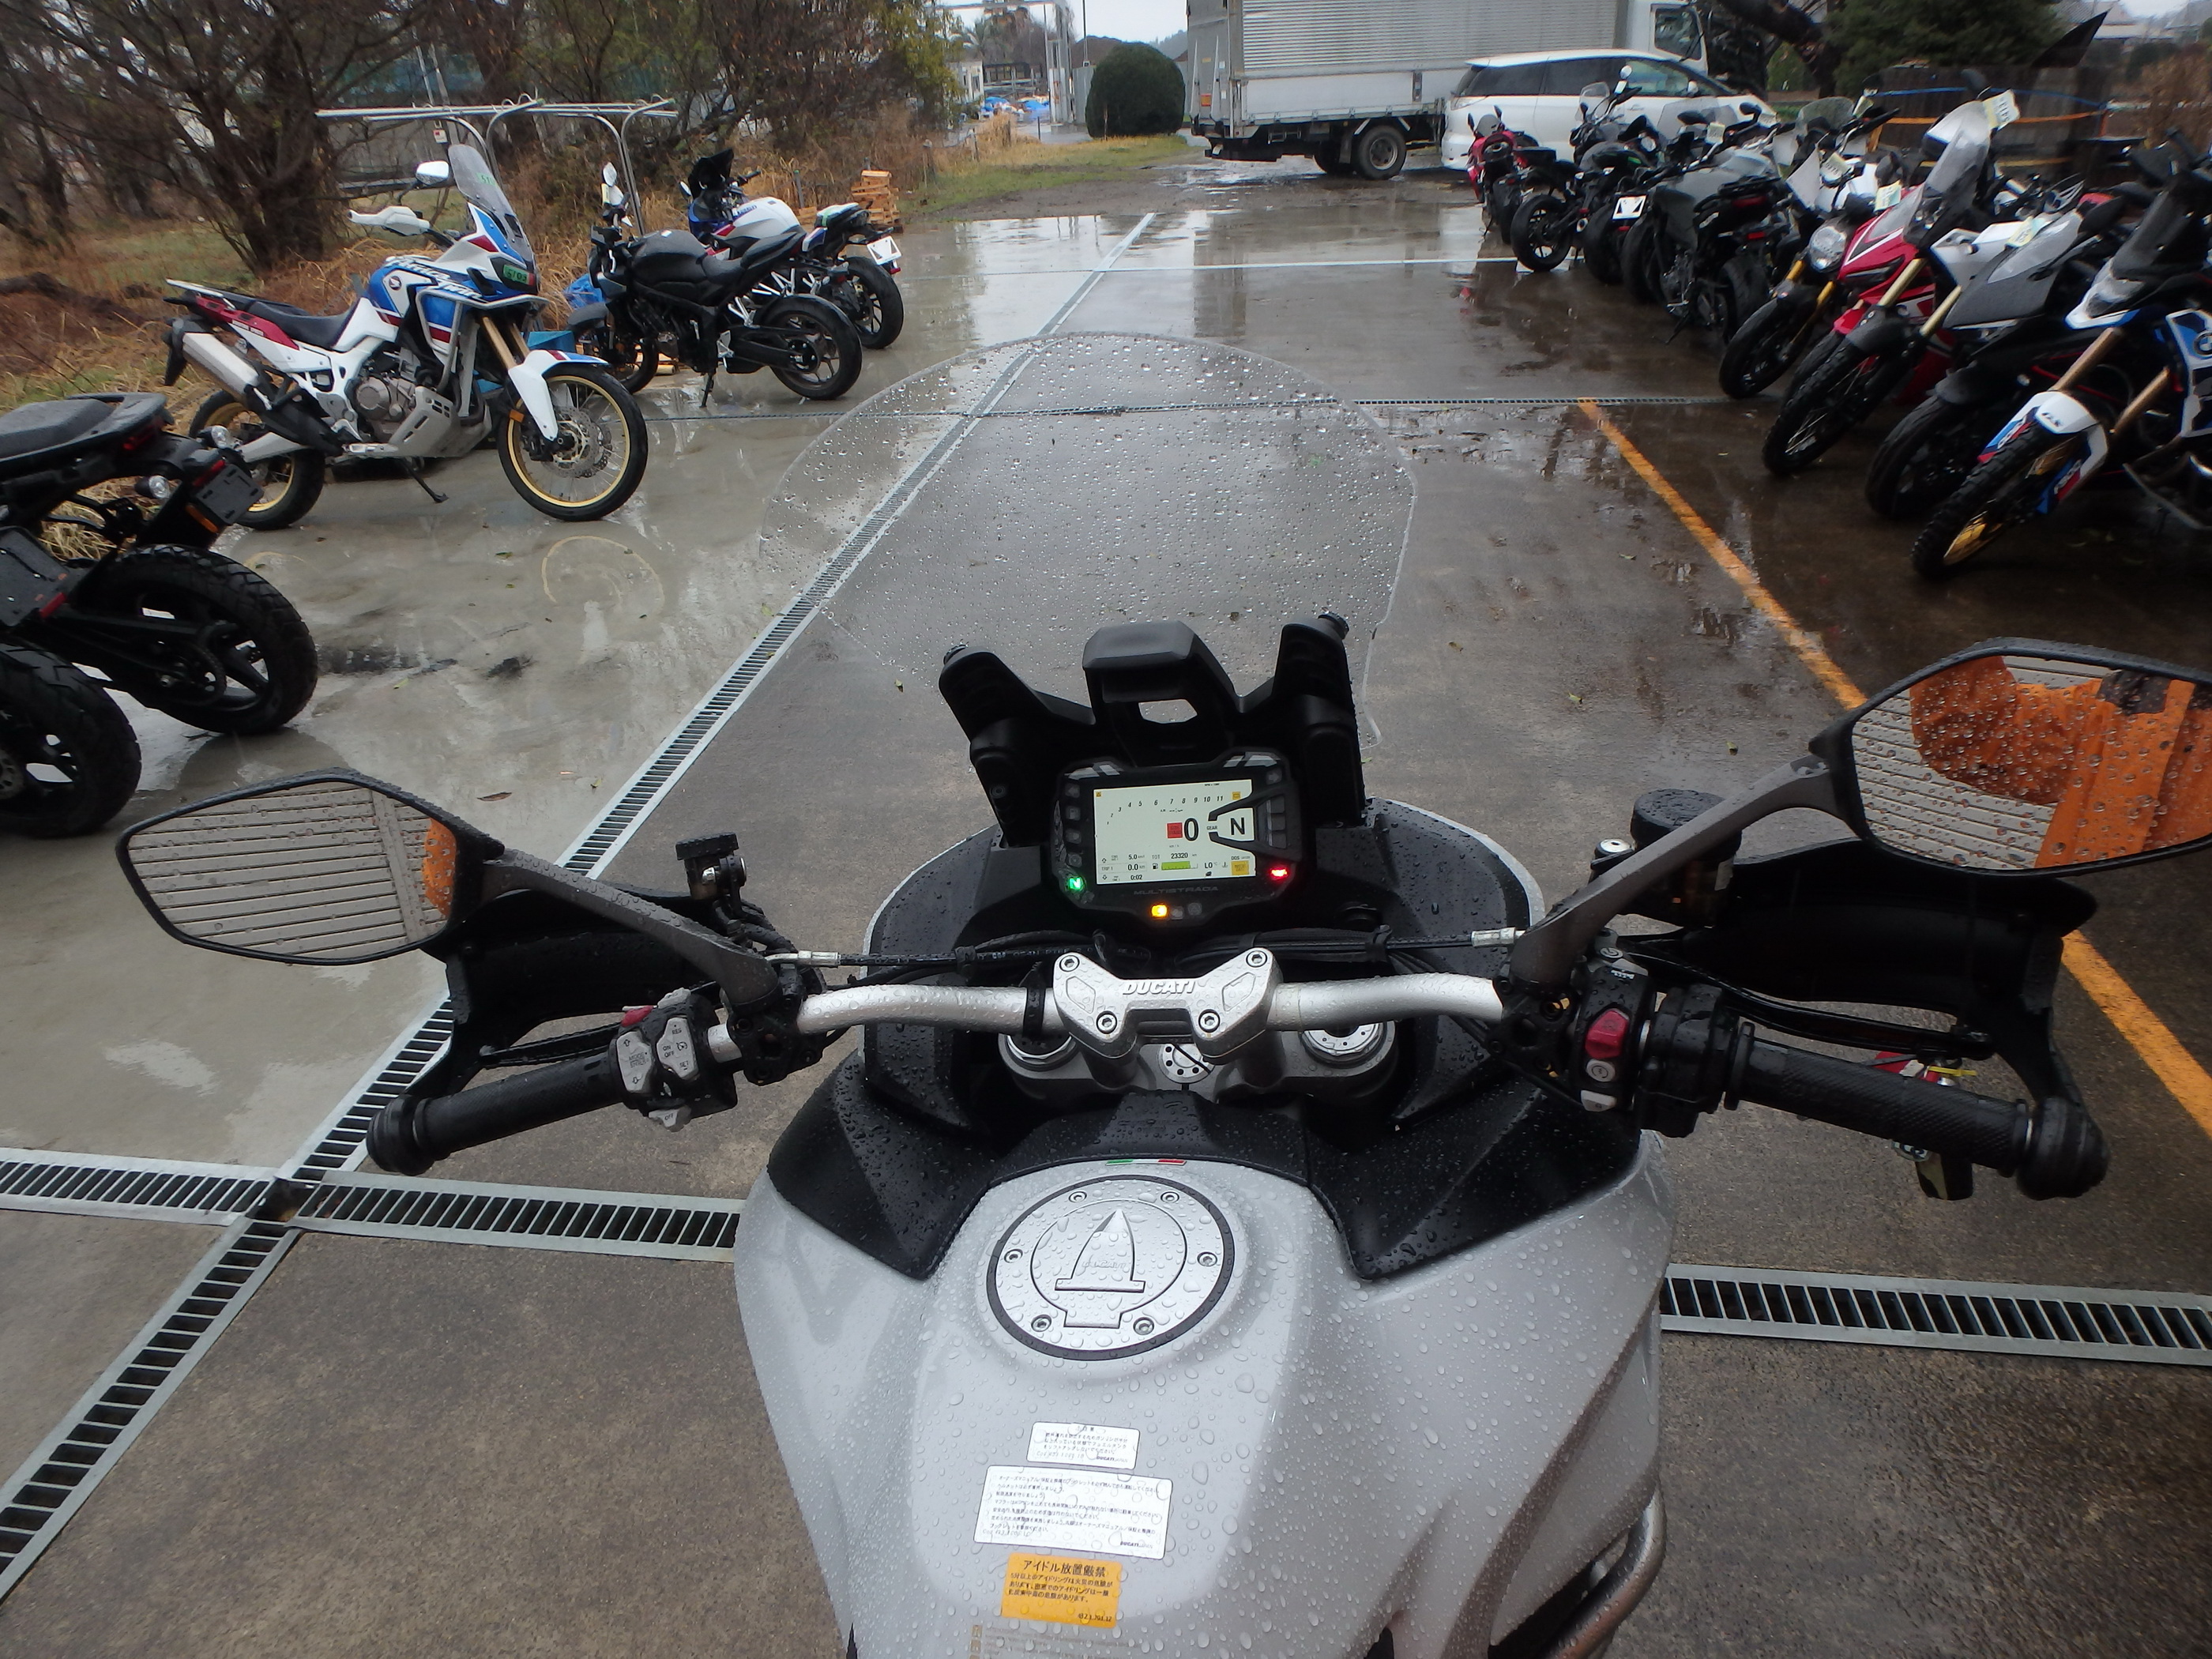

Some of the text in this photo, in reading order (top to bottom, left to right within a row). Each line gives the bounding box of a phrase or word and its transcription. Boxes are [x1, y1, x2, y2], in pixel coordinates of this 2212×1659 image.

[1183, 818, 1199, 841] 0
[1230, 817, 1245, 836] N
[1070, 877, 1082, 890] N
[1133, 886, 1219, 895] MULTISTRADA
[1122, 980, 1196, 995] DUCATI
[1024, 1559, 1107, 1578] アイドル放置厳禁
